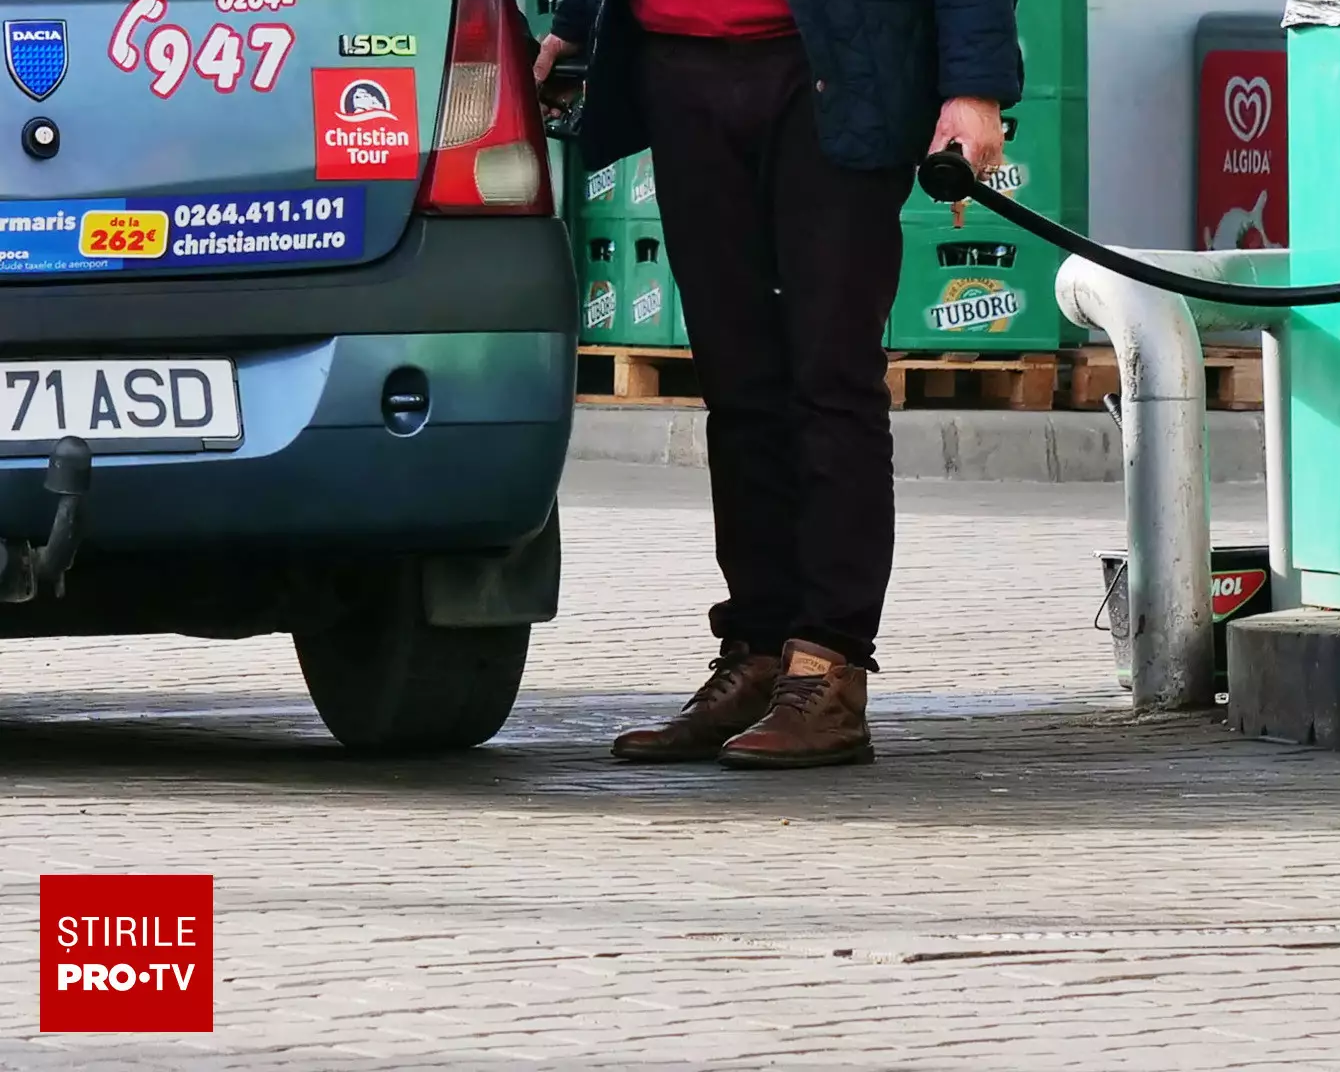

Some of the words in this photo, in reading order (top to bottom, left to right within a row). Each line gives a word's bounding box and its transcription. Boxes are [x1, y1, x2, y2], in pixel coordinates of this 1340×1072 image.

[13, 30, 62, 42] DACIA
[147, 25, 294, 98] 947
[325, 127, 409, 147] Christian
[347, 147, 390, 165] Tour
[1223, 148, 1271, 174] ALGIDA
[109, 216, 126, 228] de
[129, 216, 140, 228] la
[174, 197, 345, 228] 0264.411.101
[90, 228, 157, 252] 262€
[173, 230, 346, 256] christiantour.ro
[54, 259, 67, 270] de
[930, 292, 1018, 329] TUBORG
[5, 368, 67, 431] 71
[89, 368, 214, 429] ASD
